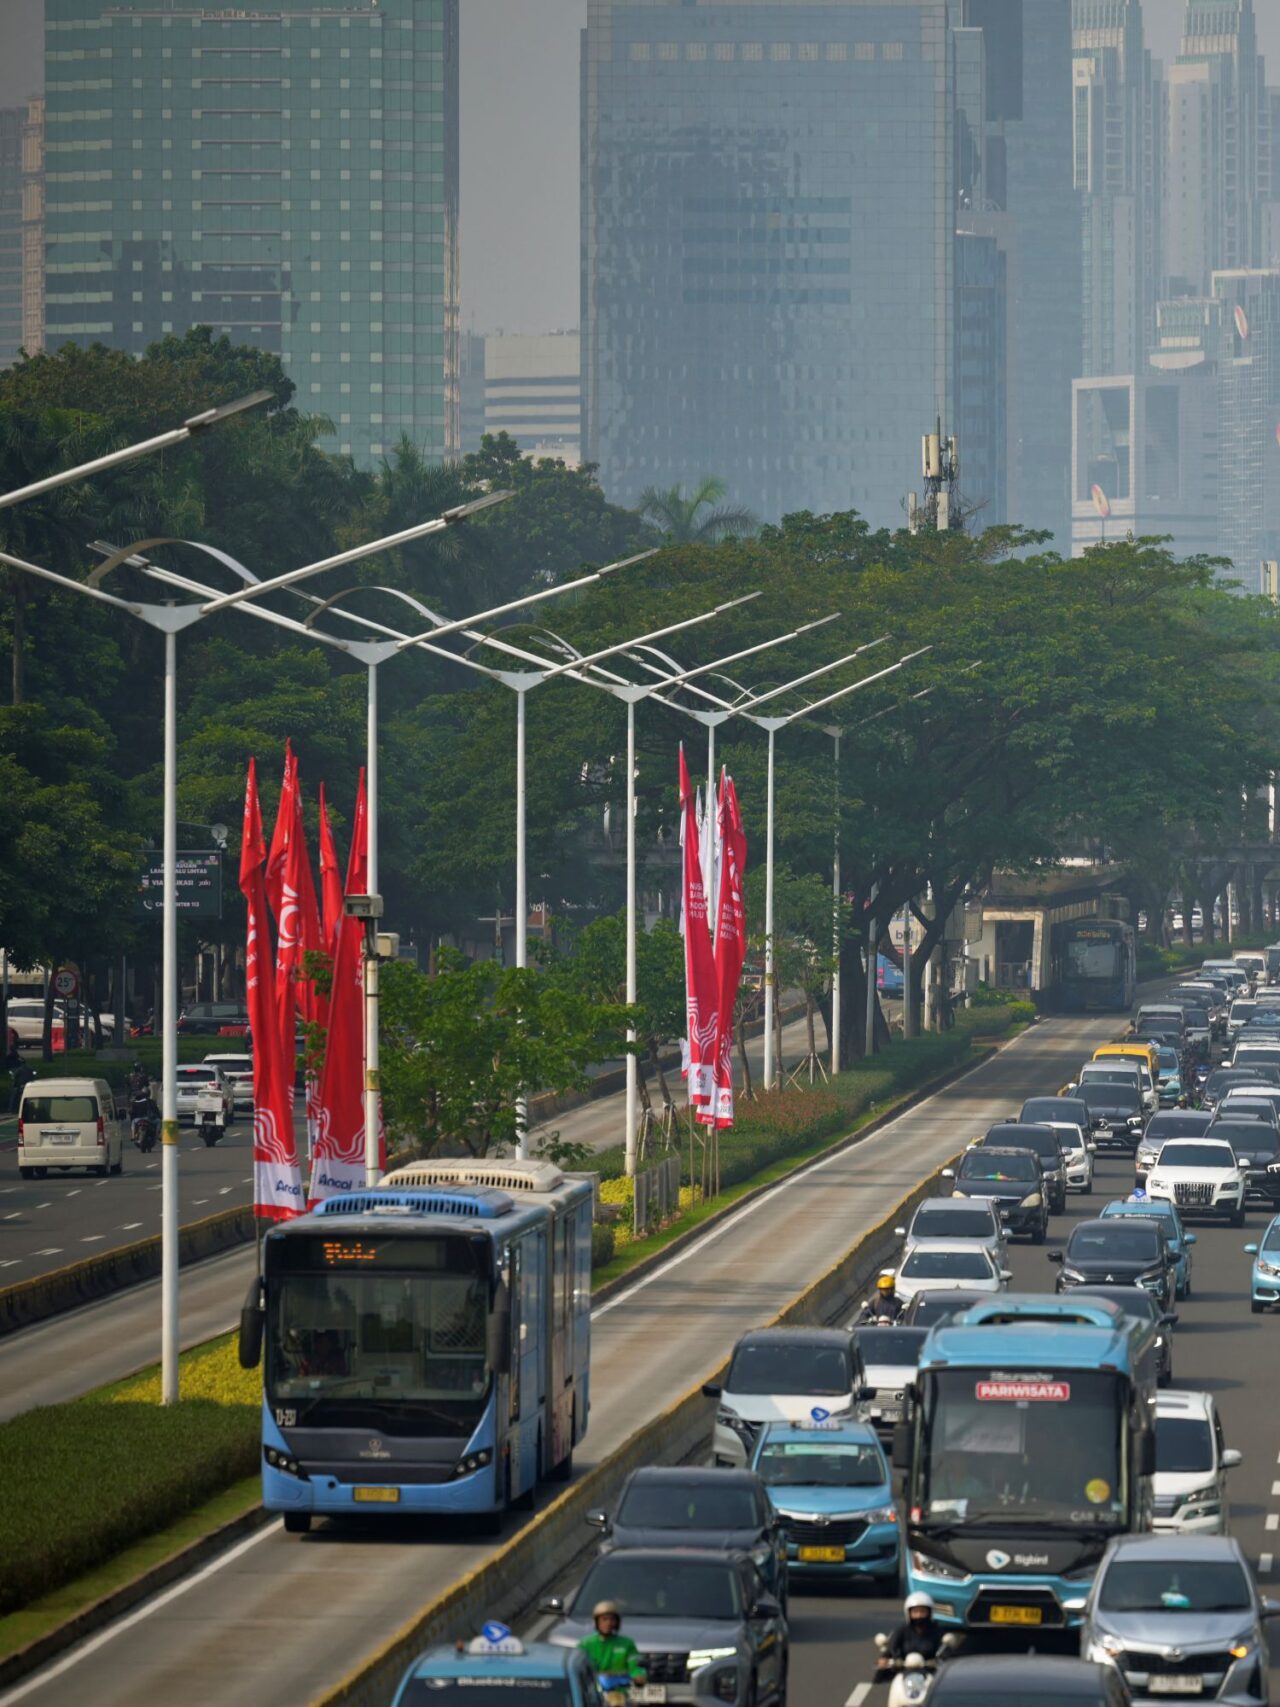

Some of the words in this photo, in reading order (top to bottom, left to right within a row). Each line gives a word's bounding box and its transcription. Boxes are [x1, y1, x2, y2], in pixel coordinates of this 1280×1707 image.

[319, 1173, 353, 1191] Ancol
[981, 1384, 1065, 1399] PARIWISATA
[1014, 1553, 1049, 1567] Bigbird
